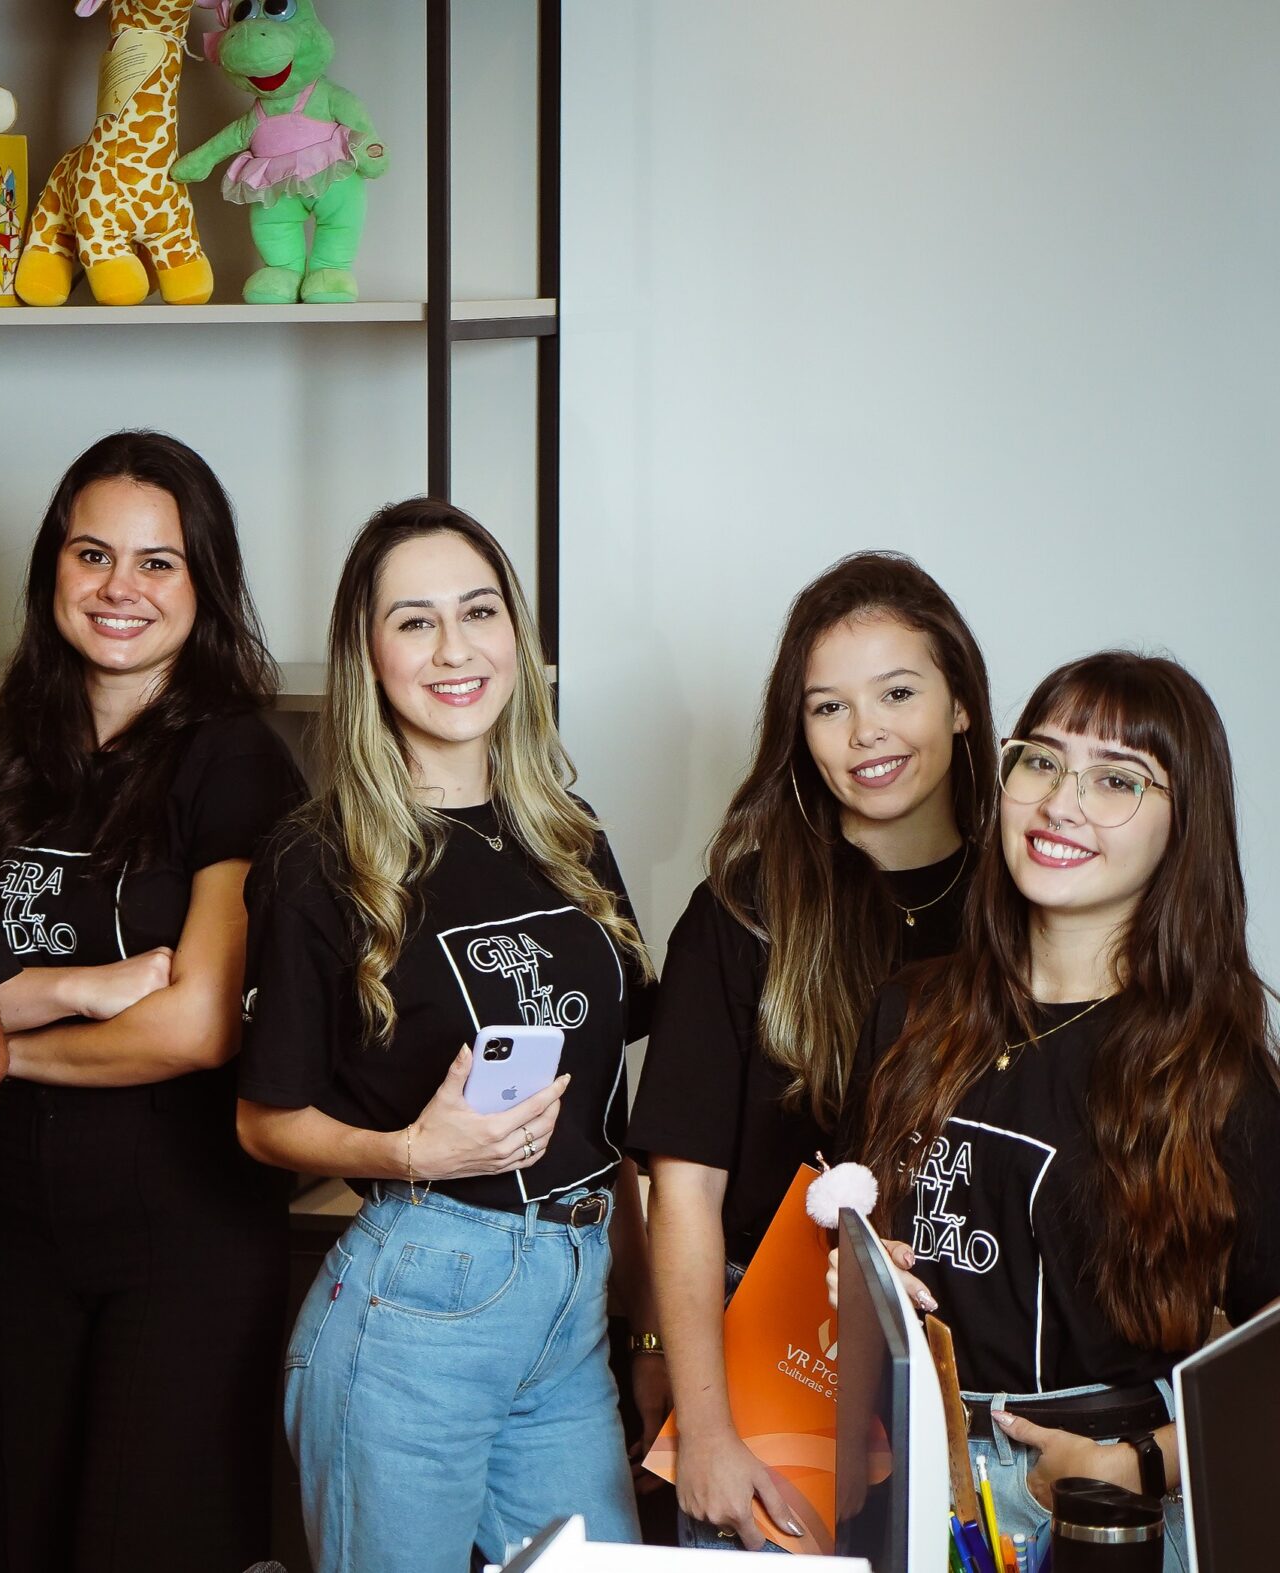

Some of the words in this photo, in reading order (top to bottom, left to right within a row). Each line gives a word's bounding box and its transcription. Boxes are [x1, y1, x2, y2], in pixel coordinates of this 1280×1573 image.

[2, 914, 77, 954] DÃO
[466, 933, 553, 973] GRA
[913, 1214, 999, 1274] DÃO
[787, 1343, 810, 1369] VR
[777, 1360, 824, 1393] Culturais
[825, 1389, 833, 1398] e
